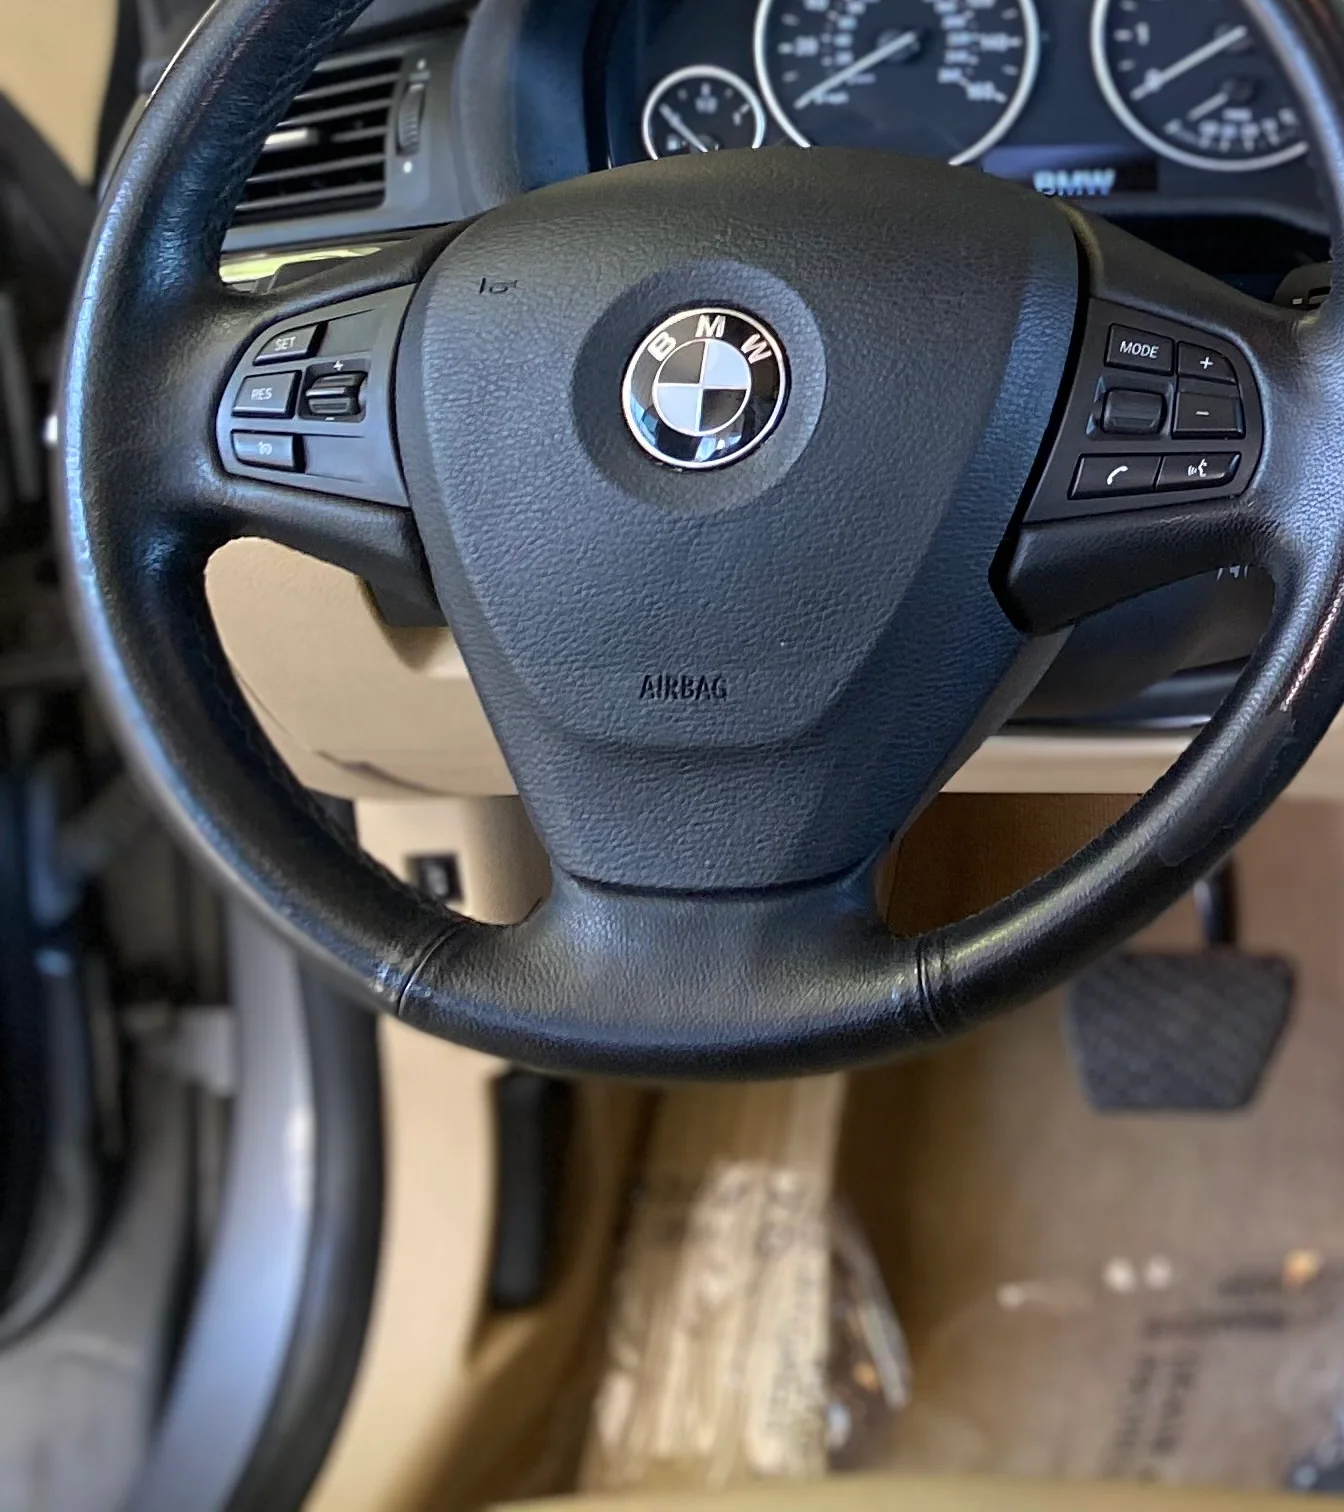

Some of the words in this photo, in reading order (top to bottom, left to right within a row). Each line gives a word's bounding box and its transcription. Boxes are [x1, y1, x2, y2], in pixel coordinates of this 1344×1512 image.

[1034, 169, 1115, 196] BMW
[274, 336, 296, 351] SET
[647, 314, 774, 365] BMW
[1119, 340, 1159, 359] MODE
[251, 388, 272, 400] RES
[639, 674, 728, 701] AIRBAG
